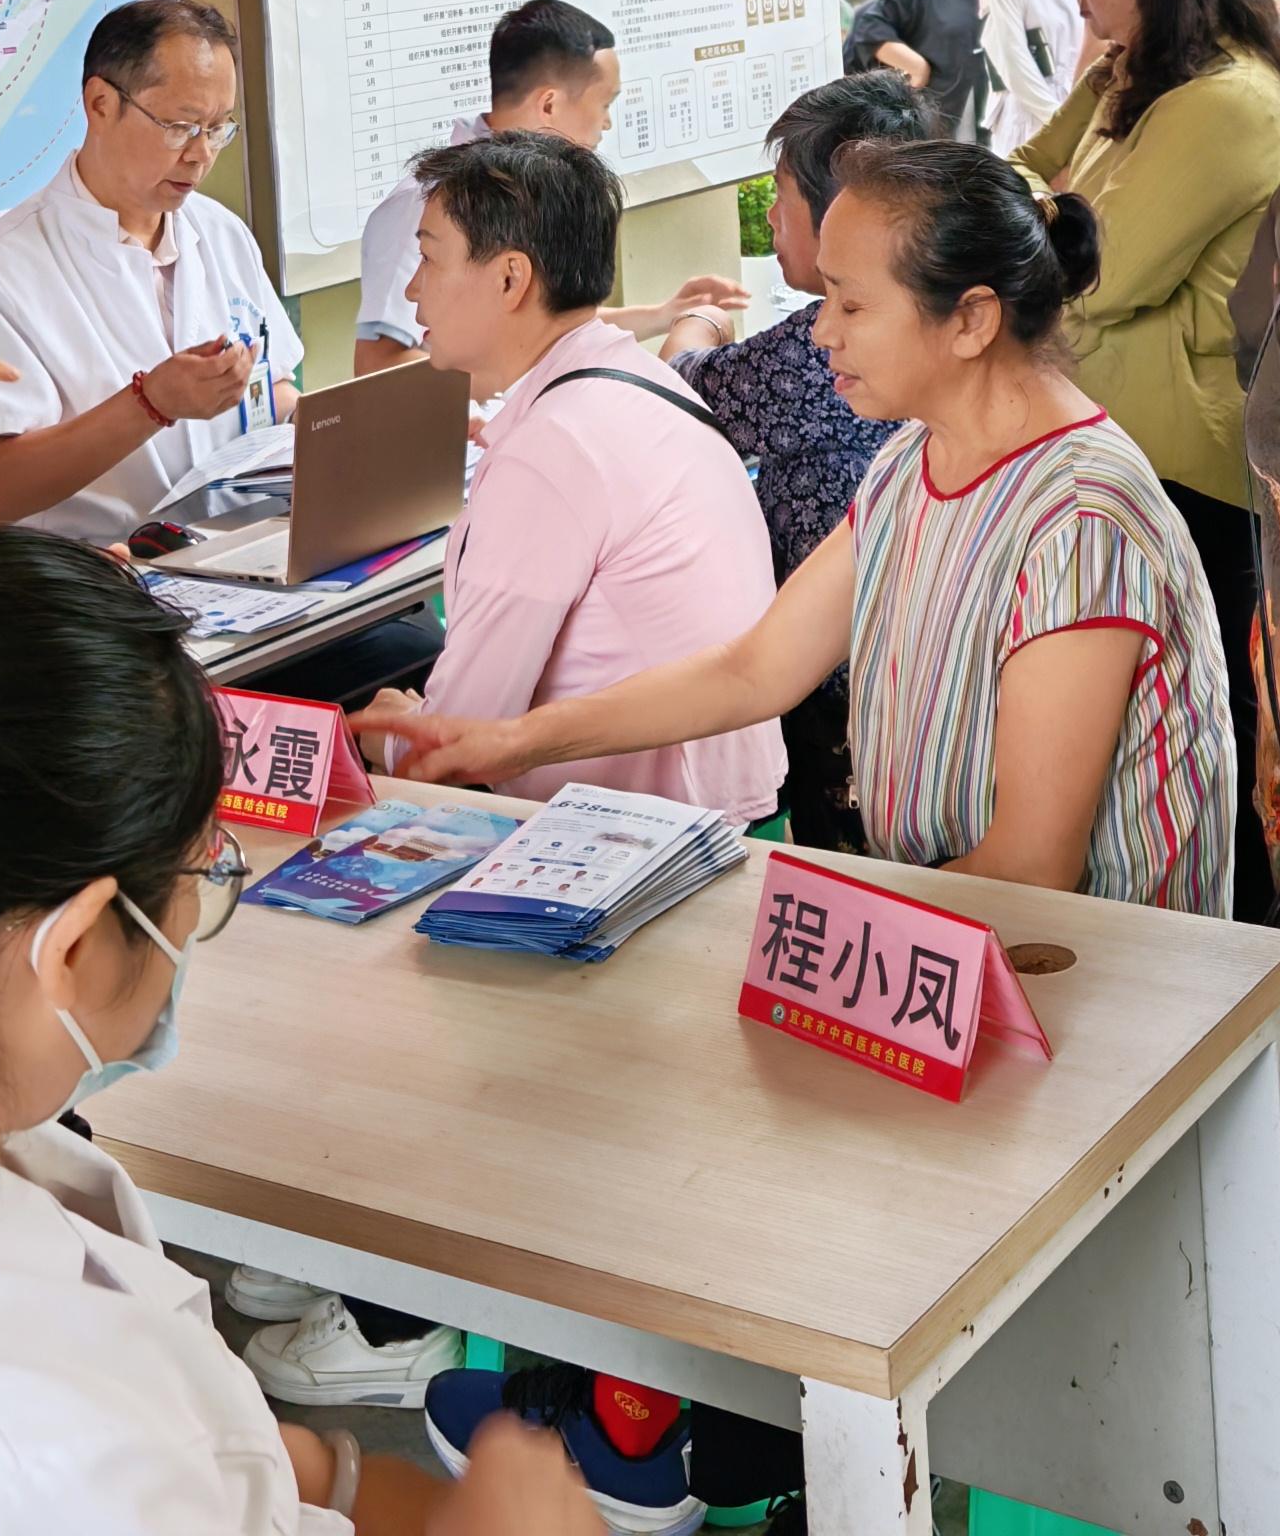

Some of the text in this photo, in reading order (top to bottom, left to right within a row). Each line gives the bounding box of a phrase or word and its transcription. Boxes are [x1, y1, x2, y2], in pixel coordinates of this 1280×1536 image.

[311, 414, 341, 432] Lenovo
[762, 893, 962, 1051] 程小凤
[787, 1008, 926, 1078] 宜宾市中西医结合医院
